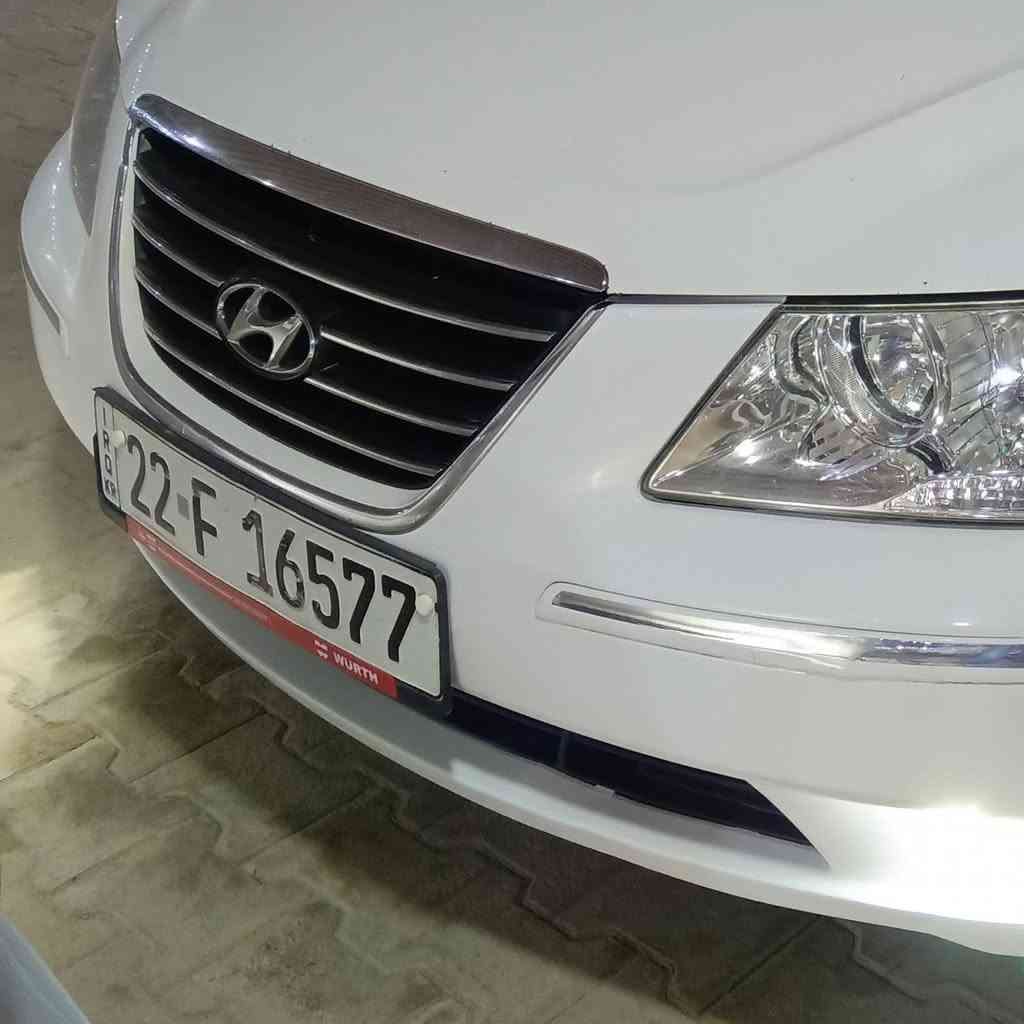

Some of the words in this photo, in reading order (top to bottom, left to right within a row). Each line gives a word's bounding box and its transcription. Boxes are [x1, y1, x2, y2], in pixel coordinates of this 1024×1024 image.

[127, 434, 176, 537] 22
[191, 476, 218, 558] F
[241, 509, 417, 663] 16577
